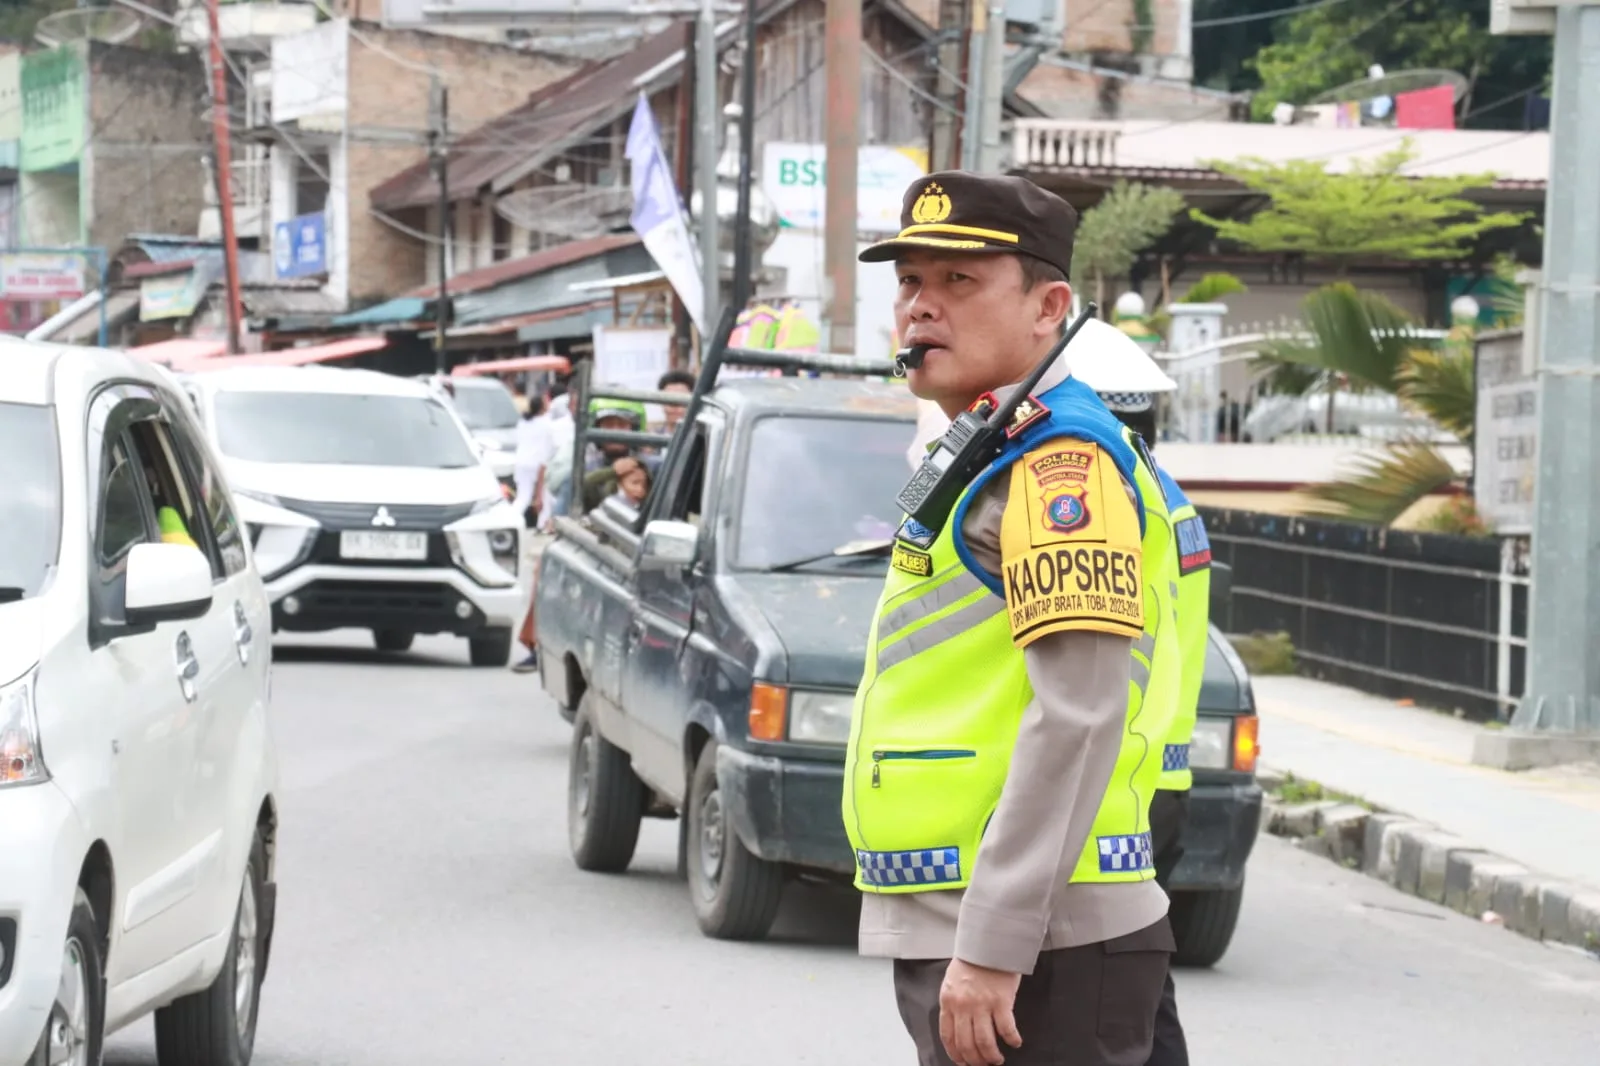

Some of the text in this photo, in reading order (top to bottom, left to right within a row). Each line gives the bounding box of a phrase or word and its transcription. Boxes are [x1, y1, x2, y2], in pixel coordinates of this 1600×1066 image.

[1034, 453, 1088, 471] POLRES
[1007, 548, 1138, 608] KAOPSRES
[1013, 594, 1140, 628] OPS MANTAP BRATA TOBA 2023-2024
